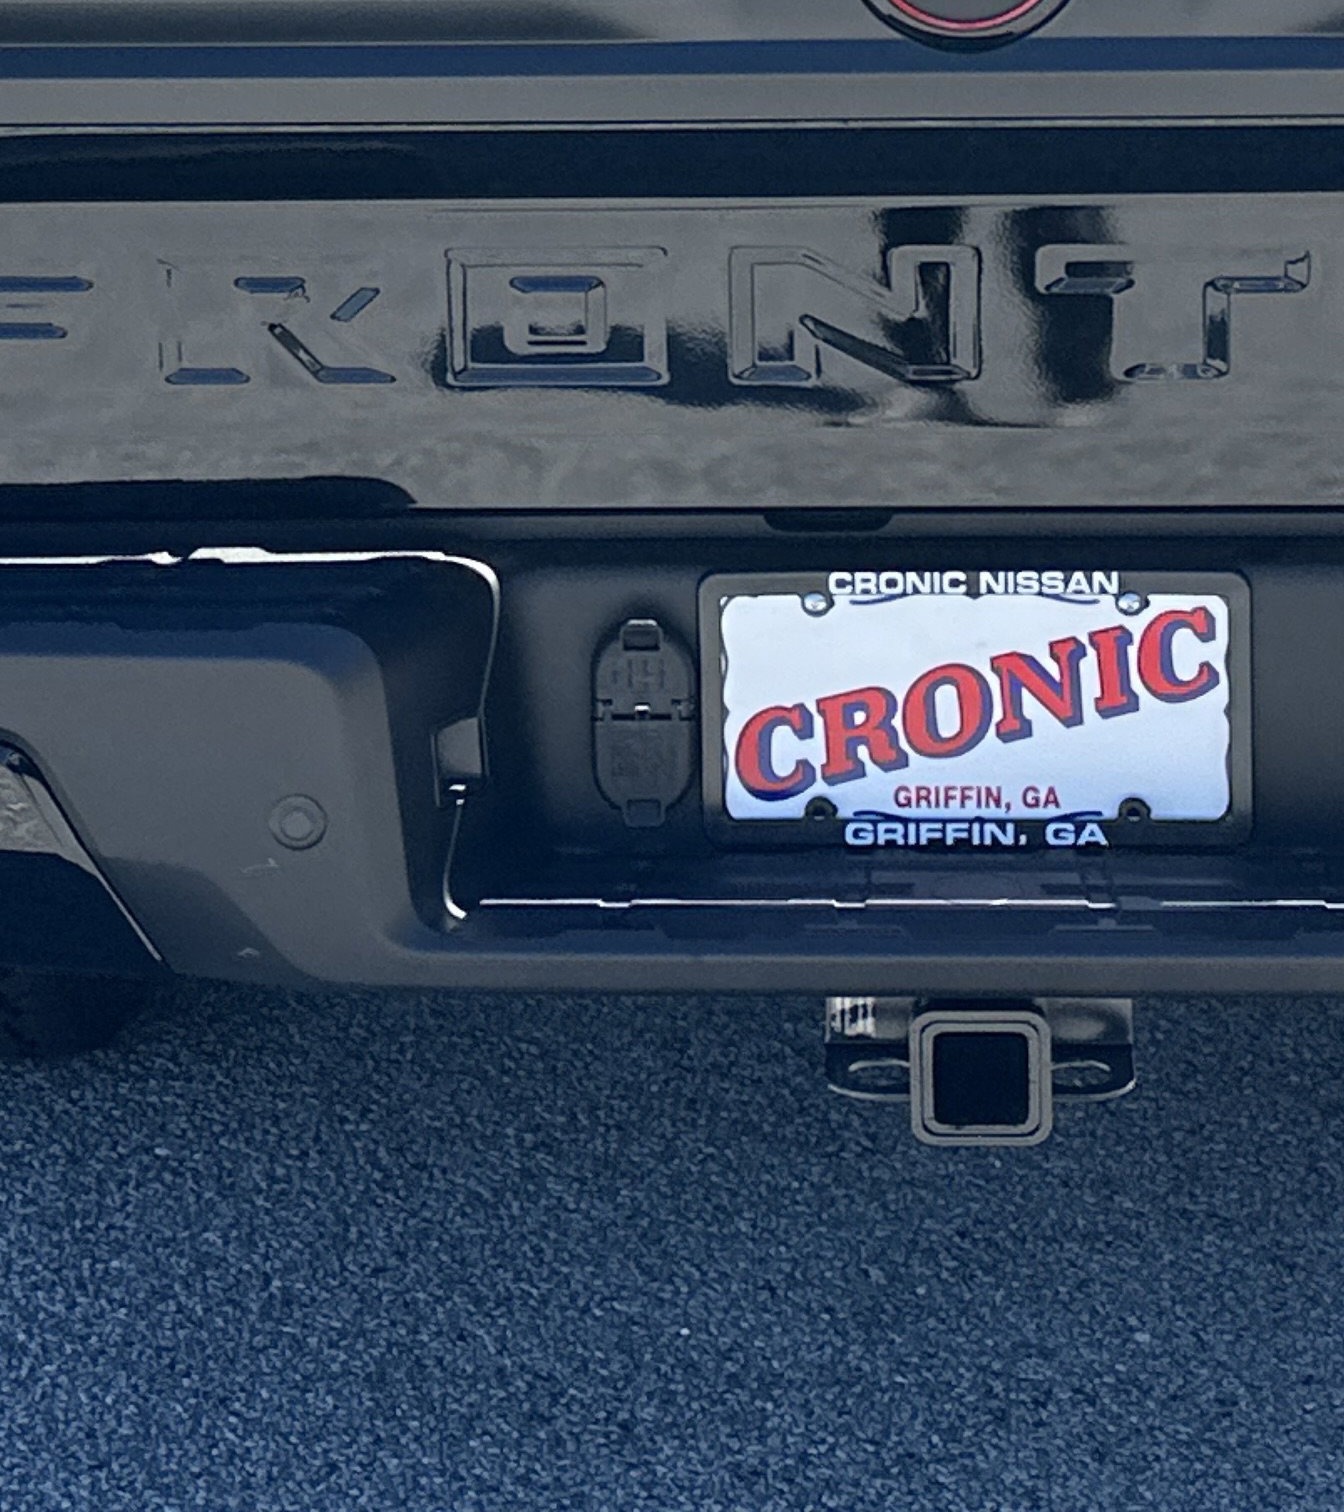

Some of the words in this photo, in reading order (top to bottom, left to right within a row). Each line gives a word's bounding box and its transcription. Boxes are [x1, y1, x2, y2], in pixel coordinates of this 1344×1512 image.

[827, 571, 967, 595] CRONIC
[979, 571, 1119, 595] NISSAN
[734, 605, 1219, 802] CRONIC
[893, 785, 1013, 814] GRIFFIN,
[1022, 785, 1061, 810] GA
[844, 822, 1027, 847] GRIFFIN,
[1045, 822, 1109, 848] GA
